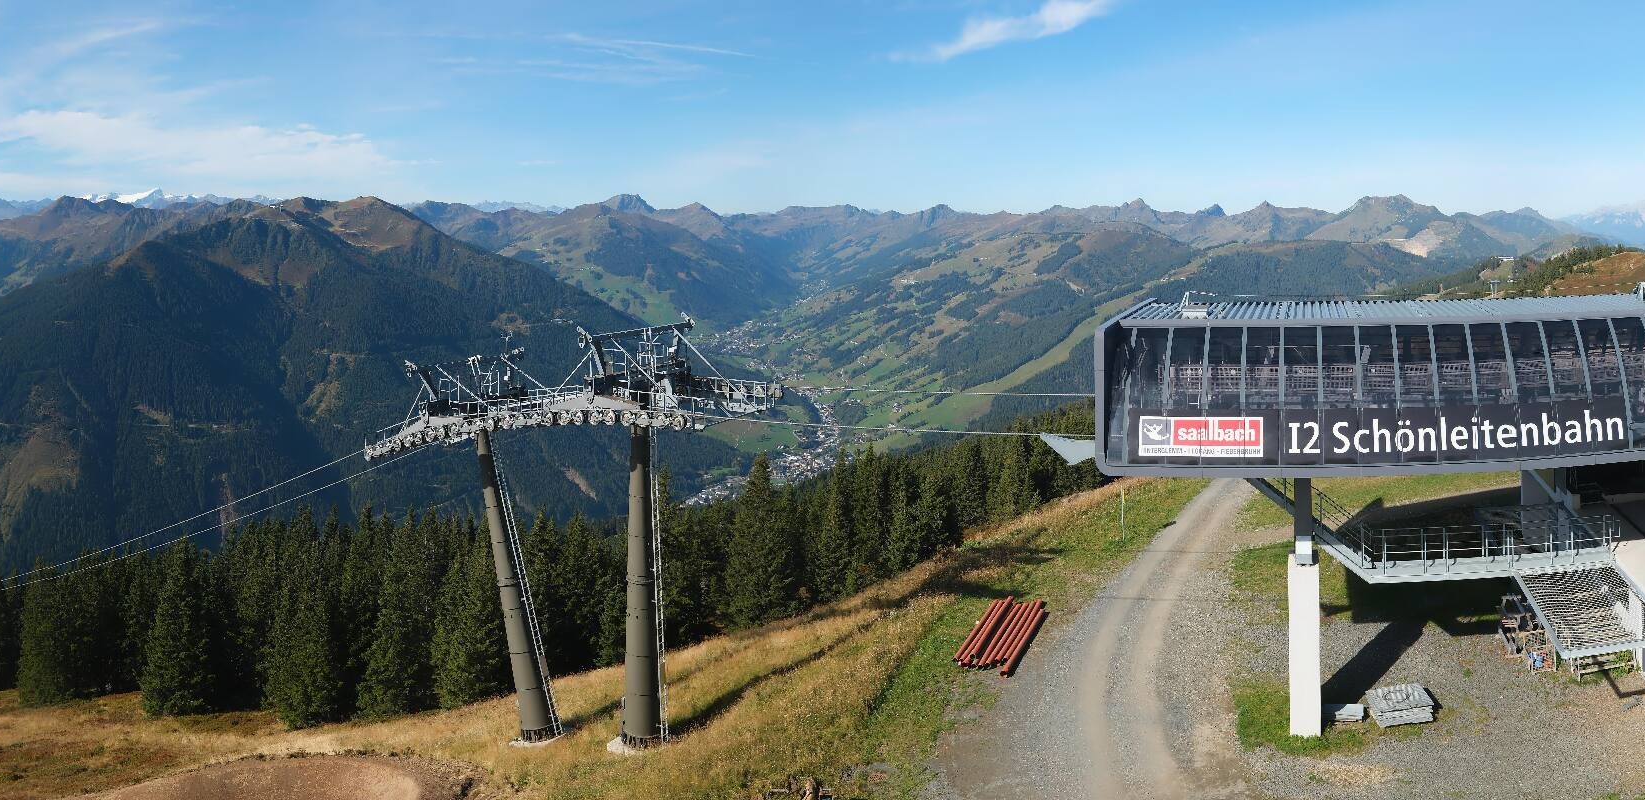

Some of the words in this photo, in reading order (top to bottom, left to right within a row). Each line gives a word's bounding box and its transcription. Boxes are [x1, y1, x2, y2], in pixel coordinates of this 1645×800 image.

[1177, 420, 1256, 442] saalbach
[1288, 422, 1321, 454] I2
[1332, 410, 1624, 454] Schönleitenbahn
